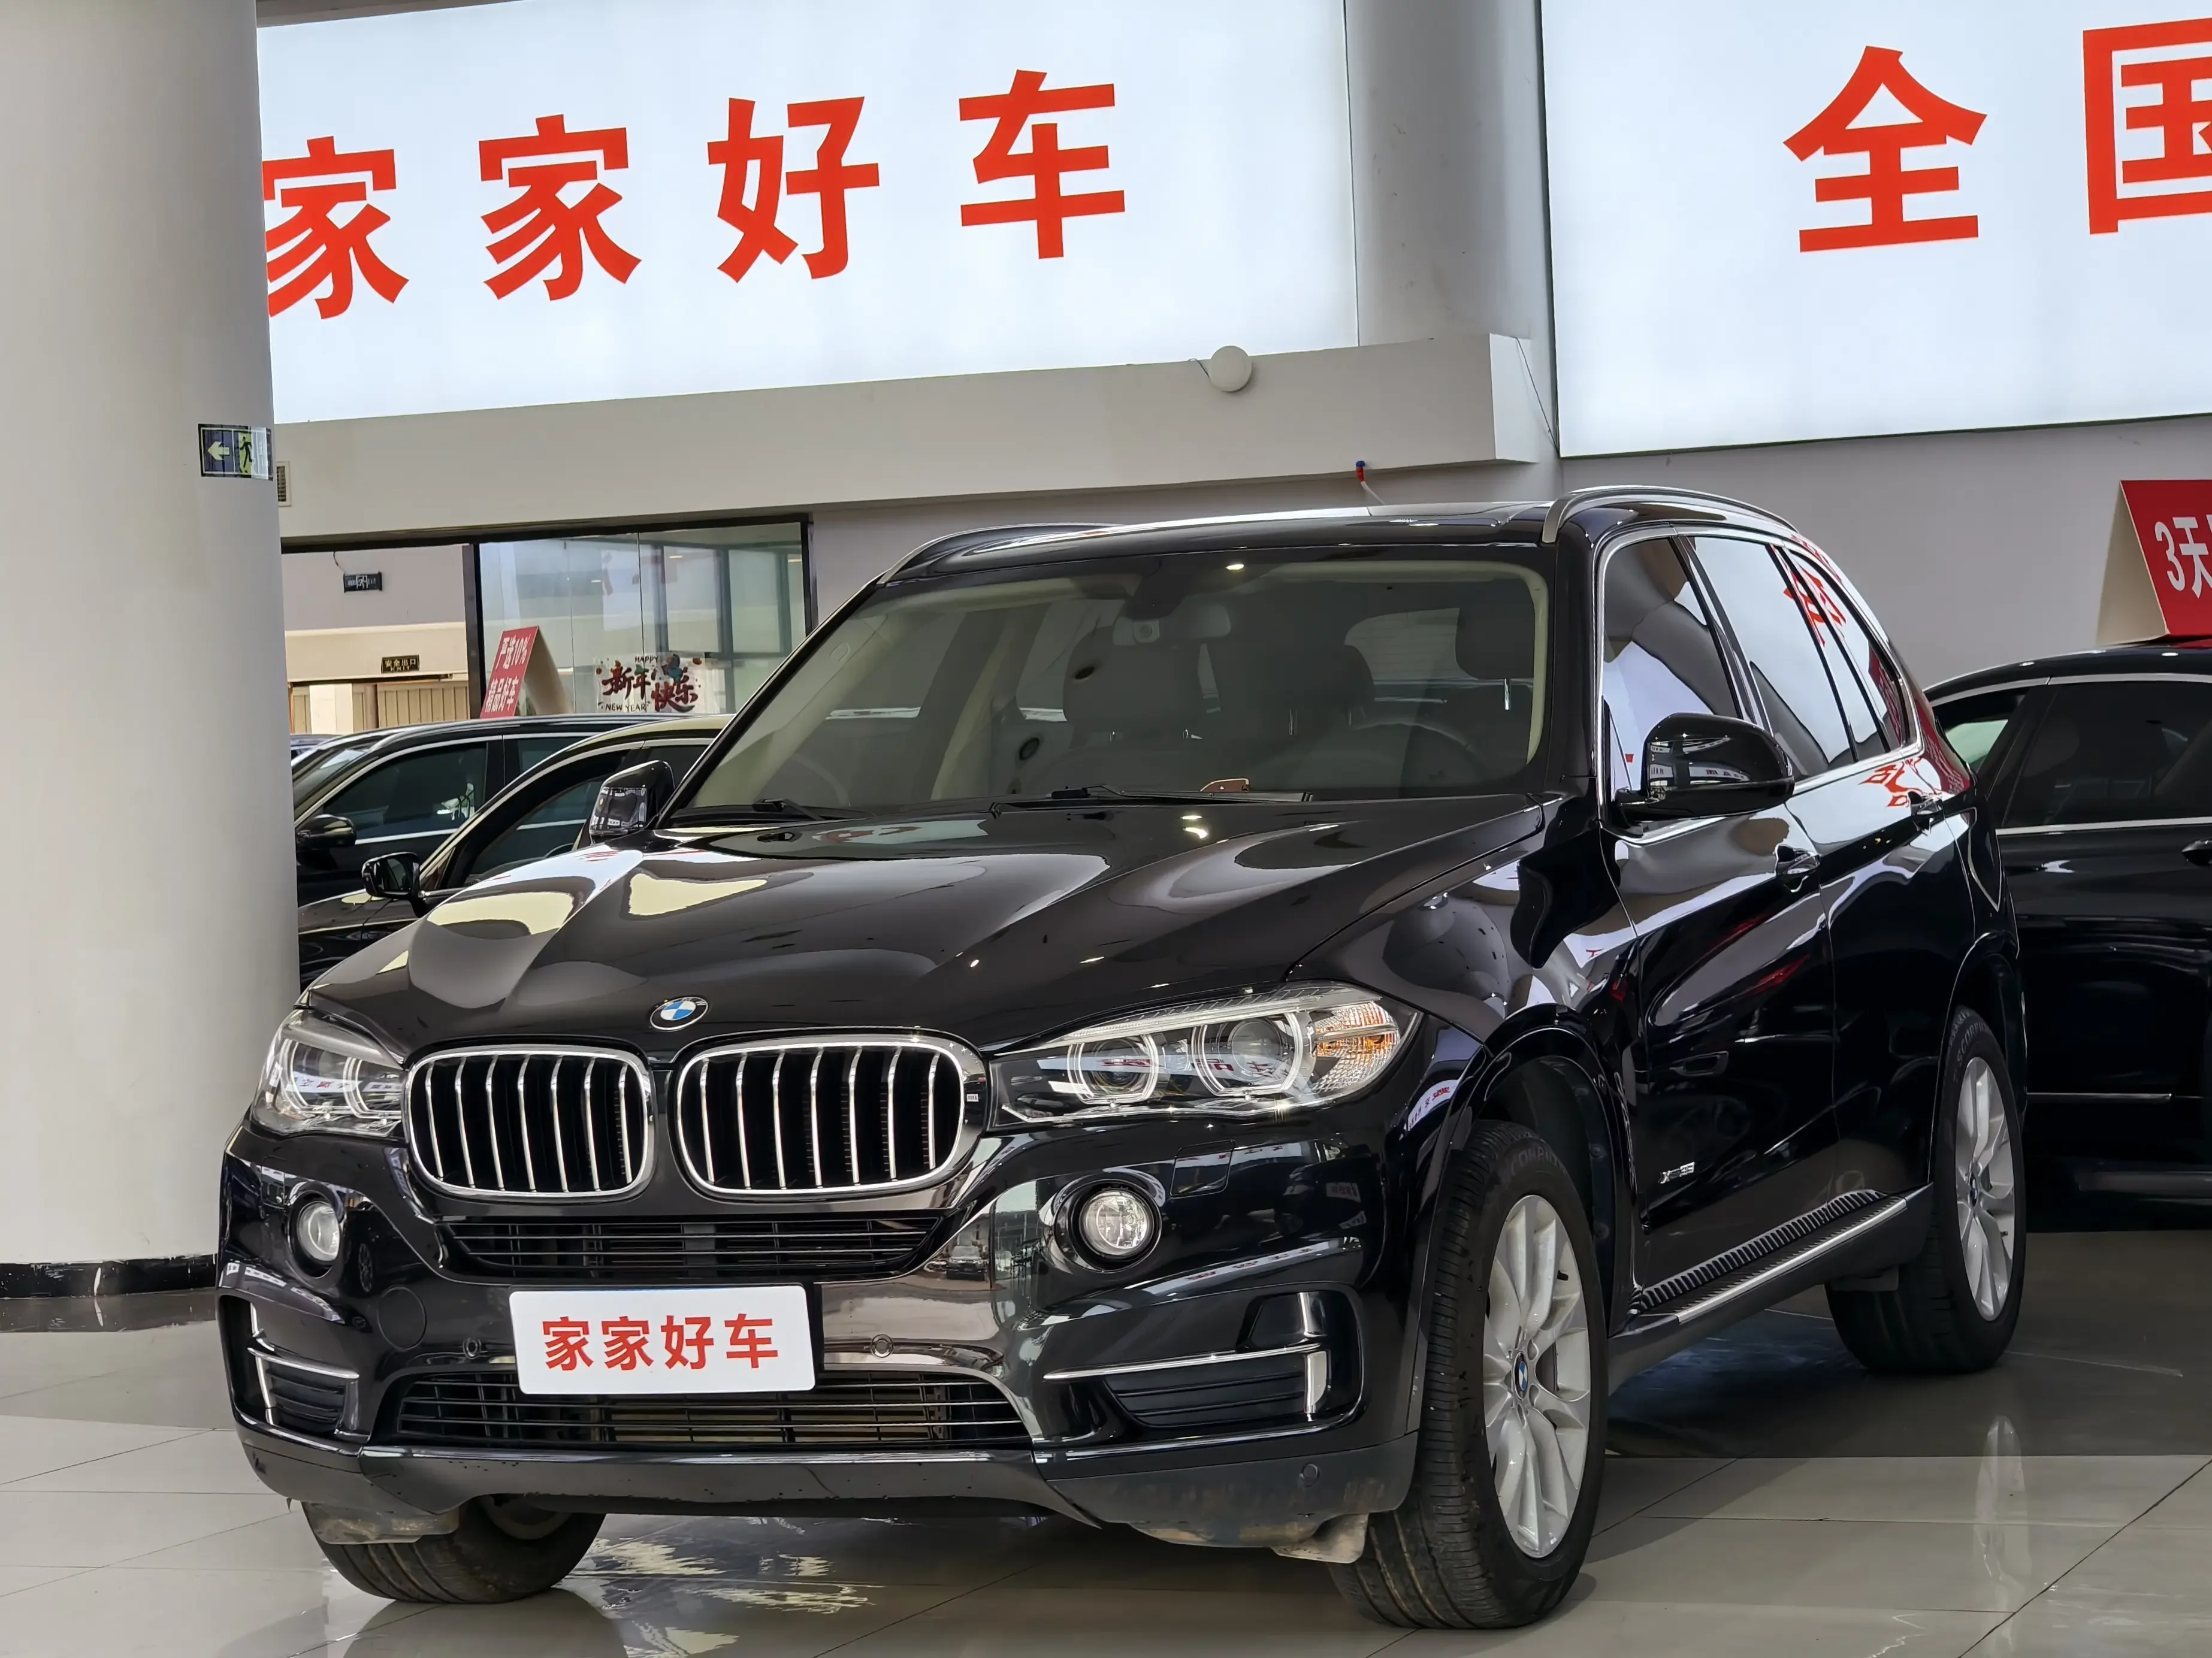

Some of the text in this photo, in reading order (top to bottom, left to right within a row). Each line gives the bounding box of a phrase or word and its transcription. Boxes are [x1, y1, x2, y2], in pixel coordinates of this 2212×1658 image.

[1782, 17, 2212, 253] 全国
[262, 69, 1126, 320] 家家好车
[2154, 514, 2212, 599] 3天
[495, 634, 531, 670] 严选10%
[542, 1313, 779, 1371] 家家好车
